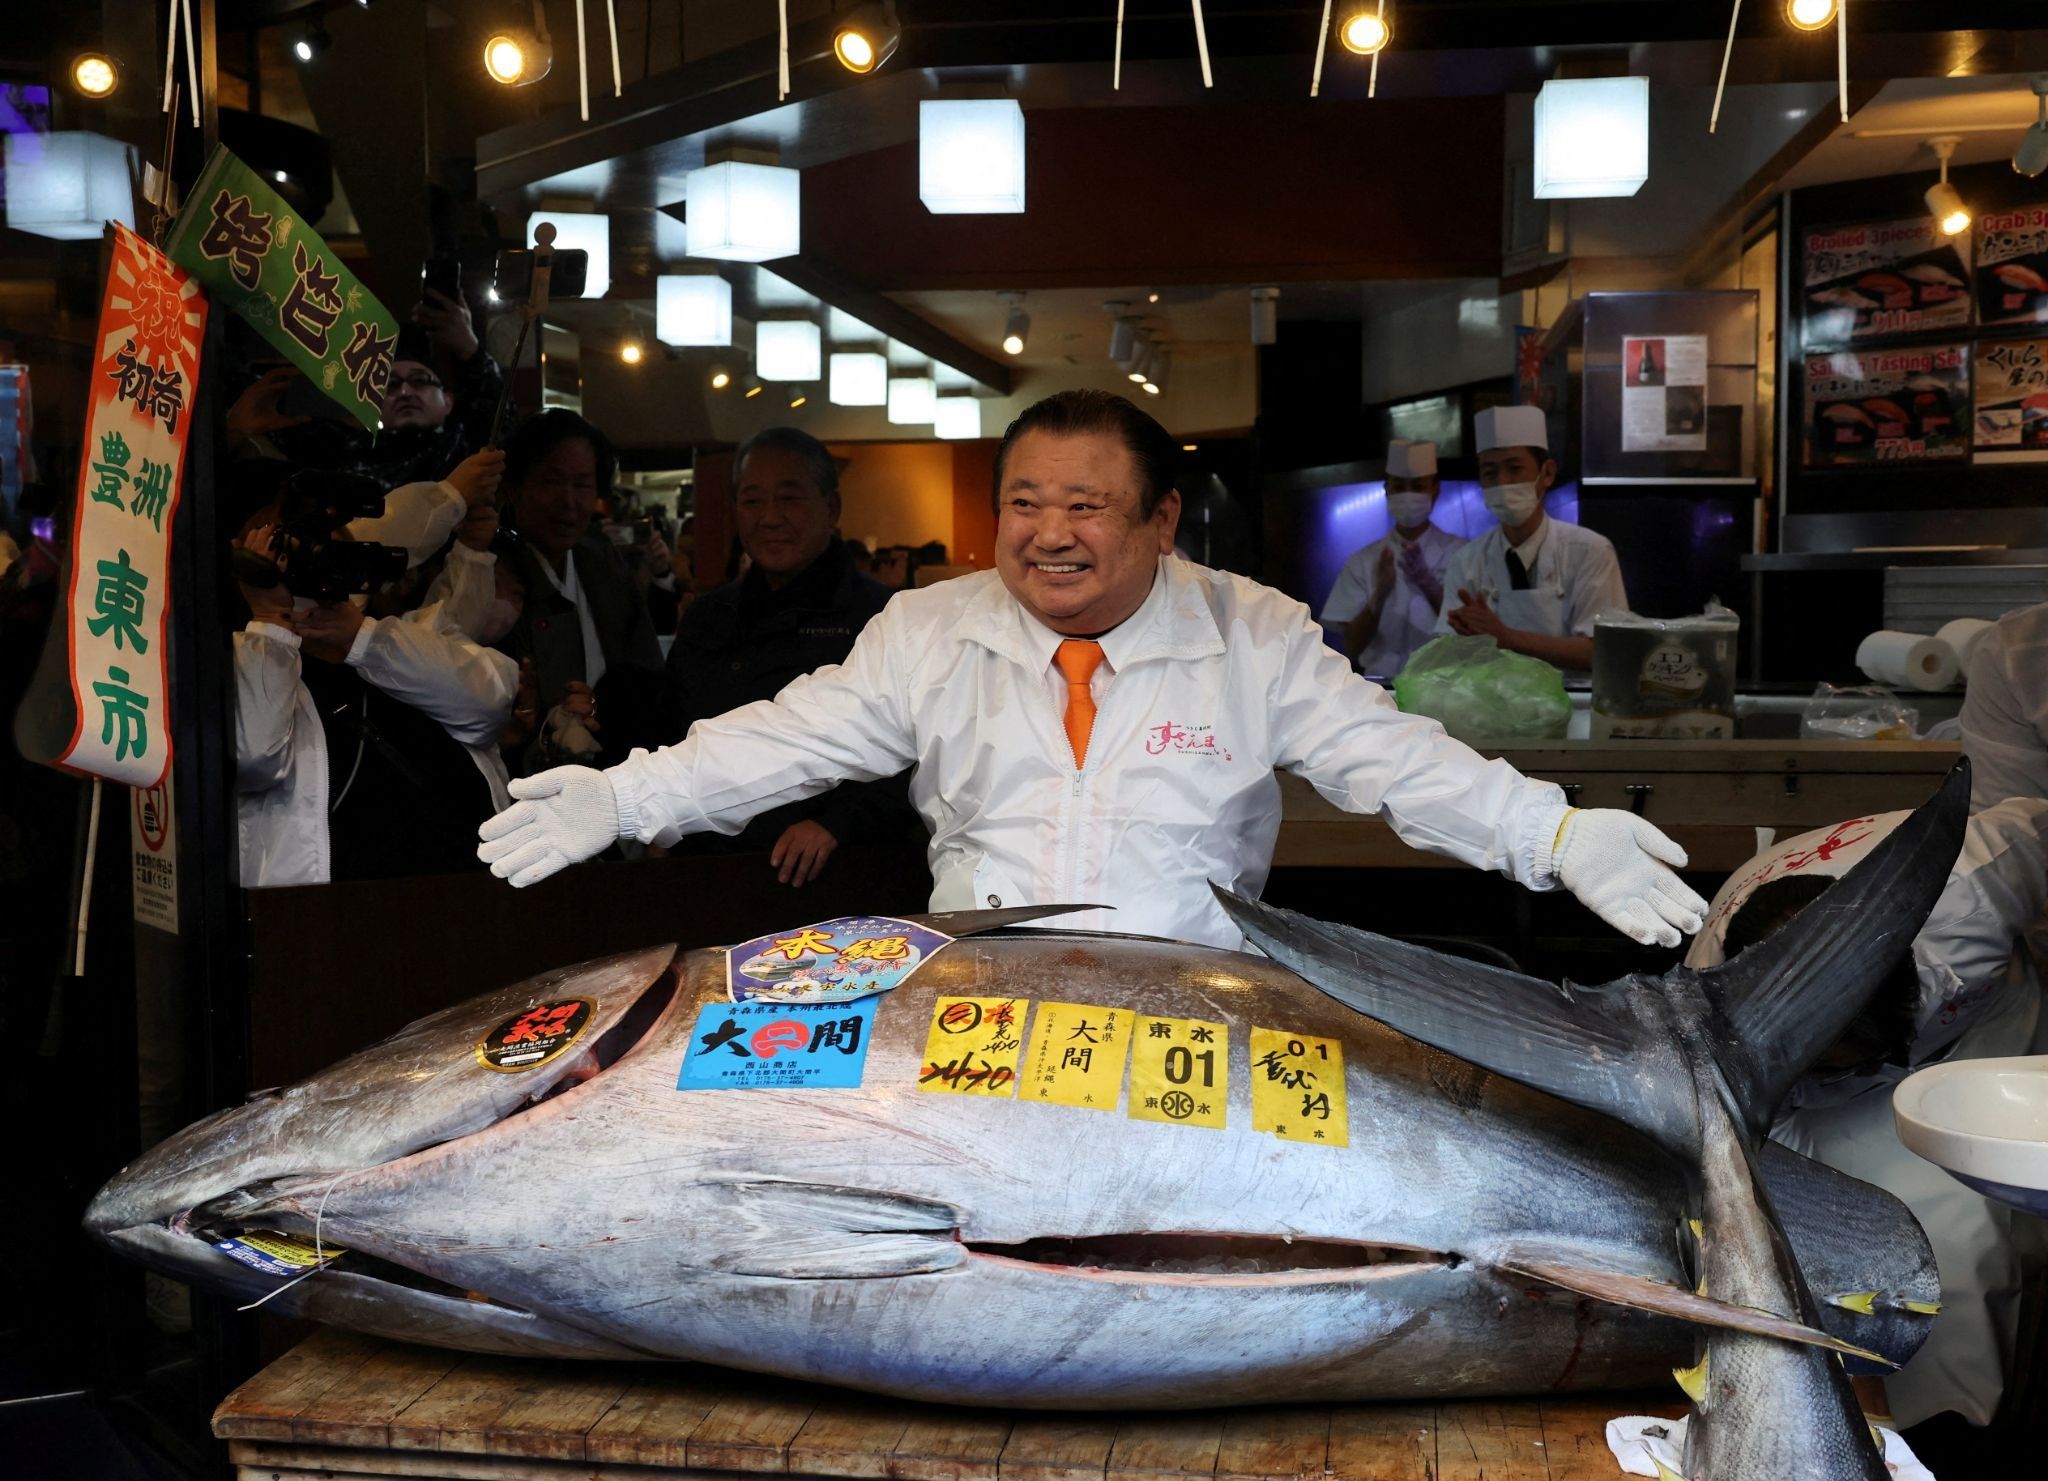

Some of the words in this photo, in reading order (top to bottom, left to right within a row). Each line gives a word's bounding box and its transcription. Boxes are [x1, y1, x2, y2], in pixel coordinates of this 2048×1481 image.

[1983, 213, 2025, 232] Crab
[1810, 232, 1864, 250] Broiled
[1872, 357, 1931, 373] Tasting
[91, 431, 172, 533] 豊洲
[1102, 1011, 1119, 1042] 青森県
[1149, 1022, 1214, 1043] 東水
[1062, 1019, 1099, 1073] 大間
[1288, 1039, 1328, 1060] 01
[1164, 1046, 1214, 1088] 01
